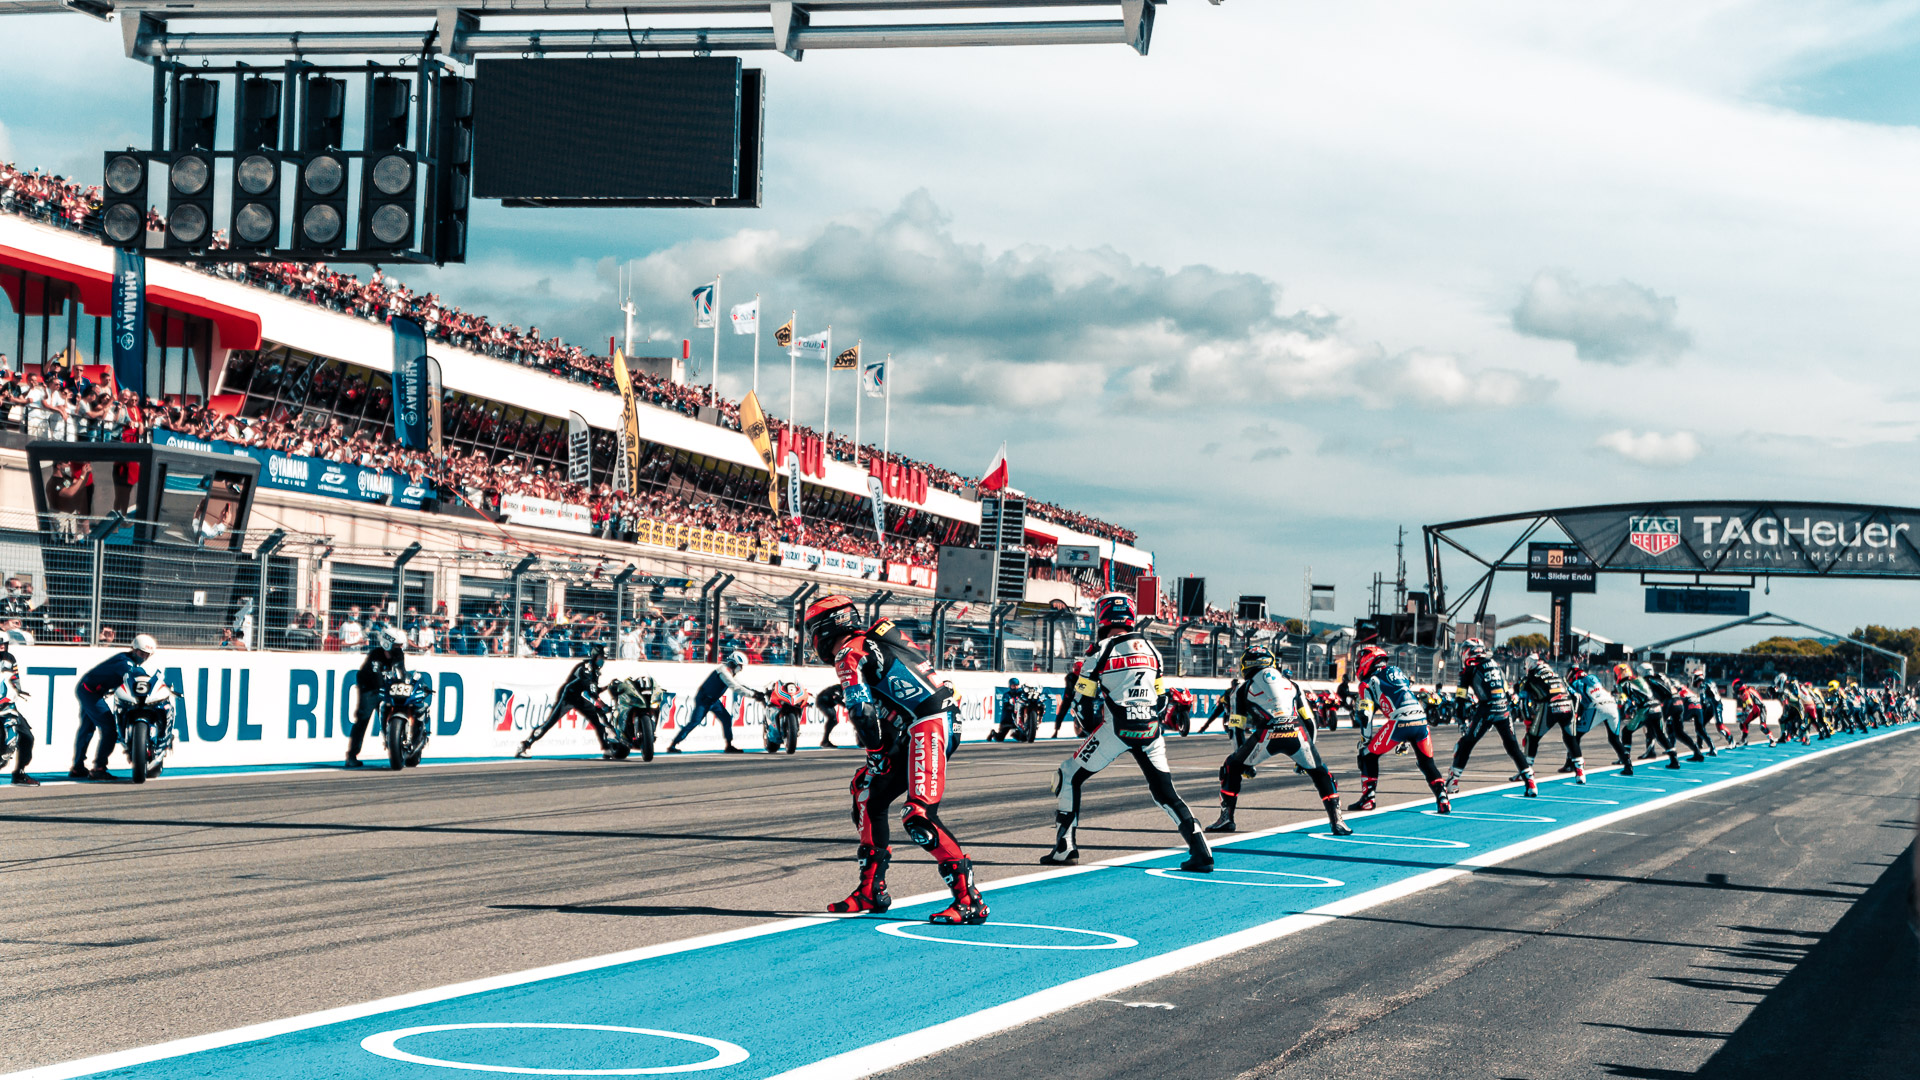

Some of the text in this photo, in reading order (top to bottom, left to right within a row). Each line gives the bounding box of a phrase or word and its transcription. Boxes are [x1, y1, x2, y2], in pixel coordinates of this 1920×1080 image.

[776, 429, 826, 480] PAUL
[278, 457, 309, 481] YAMAHA
[272, 477, 306, 488] RACING
[366, 471, 393, 495] YAMAHA
[360, 491, 381, 500] RACI
[1634, 518, 1676, 532] TAG
[1633, 533, 1678, 553] HEUER
[784, 551, 801, 561] SUZUKI
[1549, 554, 1561, 564] 20
[1702, 549, 1896, 563] OFFICIAL TIMEKEEPER
[1547, 572, 1570, 580] Slider
[1134, 671, 1145, 686] 7
[135, 681, 148, 694] 5
[389, 683, 414, 697] 333
[1128, 688, 1149, 697] YART
[1027, 692, 1040, 700] 77
[163, 667, 263, 742] AUL
[1268, 730, 1300, 740] KENNY
[914, 731, 926, 797] SUZUKI
